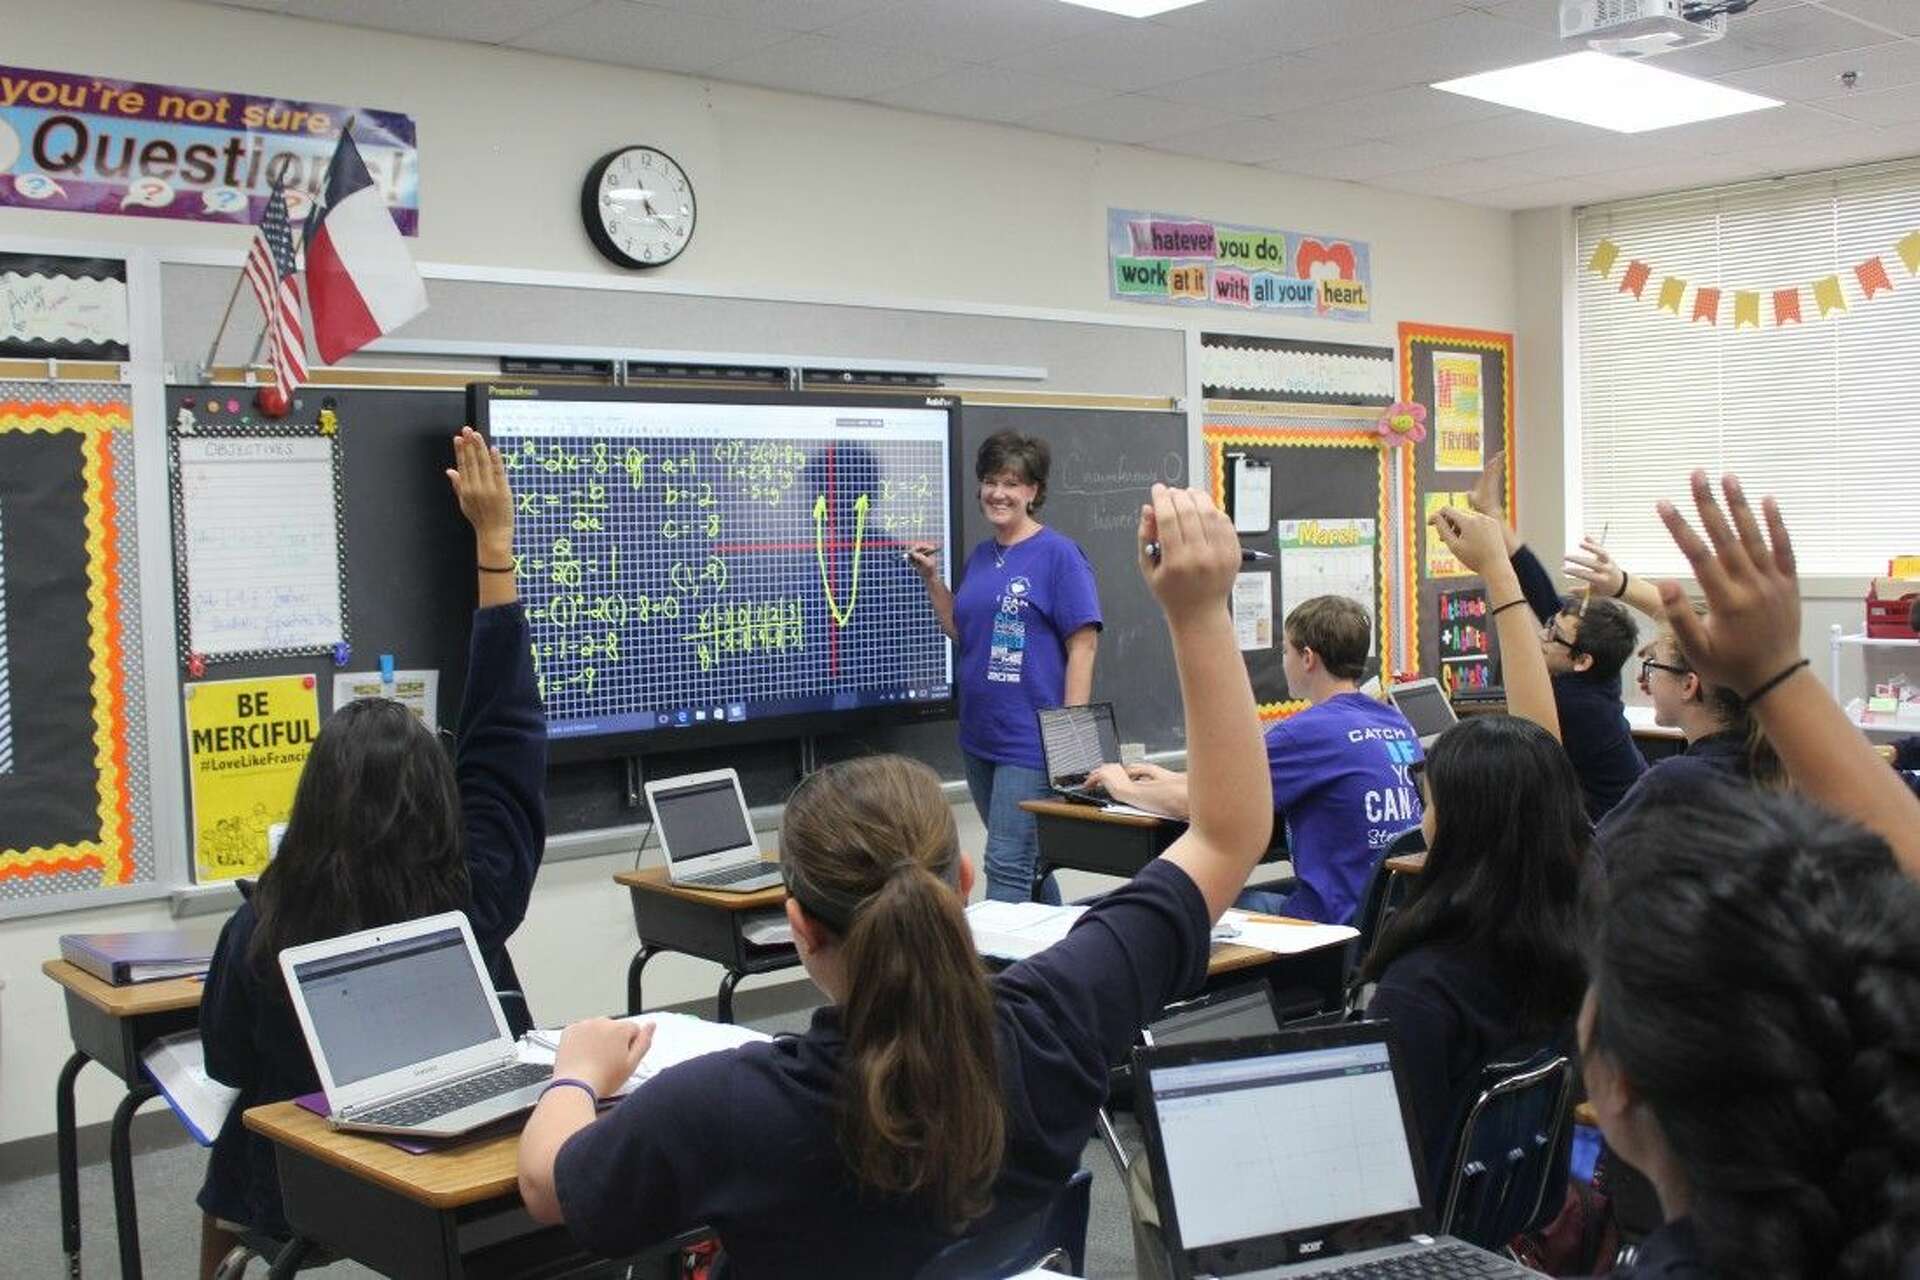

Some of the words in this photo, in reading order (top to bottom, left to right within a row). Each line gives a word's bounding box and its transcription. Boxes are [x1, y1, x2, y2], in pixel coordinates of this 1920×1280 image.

[1, 75, 146, 114] you're
[158, 93, 231, 123] not
[1219, 239, 1249, 259] you
[1255, 236, 1282, 264] do,
[1122, 261, 1168, 287] work
[1174, 269, 1190, 292] at
[1195, 267, 1204, 292] it
[1216, 276, 1249, 302] with
[1254, 279, 1274, 302] all
[1279, 285, 1313, 303] your
[1298, 520, 1360, 546] March
[237, 692, 269, 718] BE
[193, 719, 317, 754] MERCIFUL
[1348, 728, 1406, 742] CATCH
[200, 749, 306, 772] #LoveLikeFranci
[1364, 787, 1412, 823] CAN
